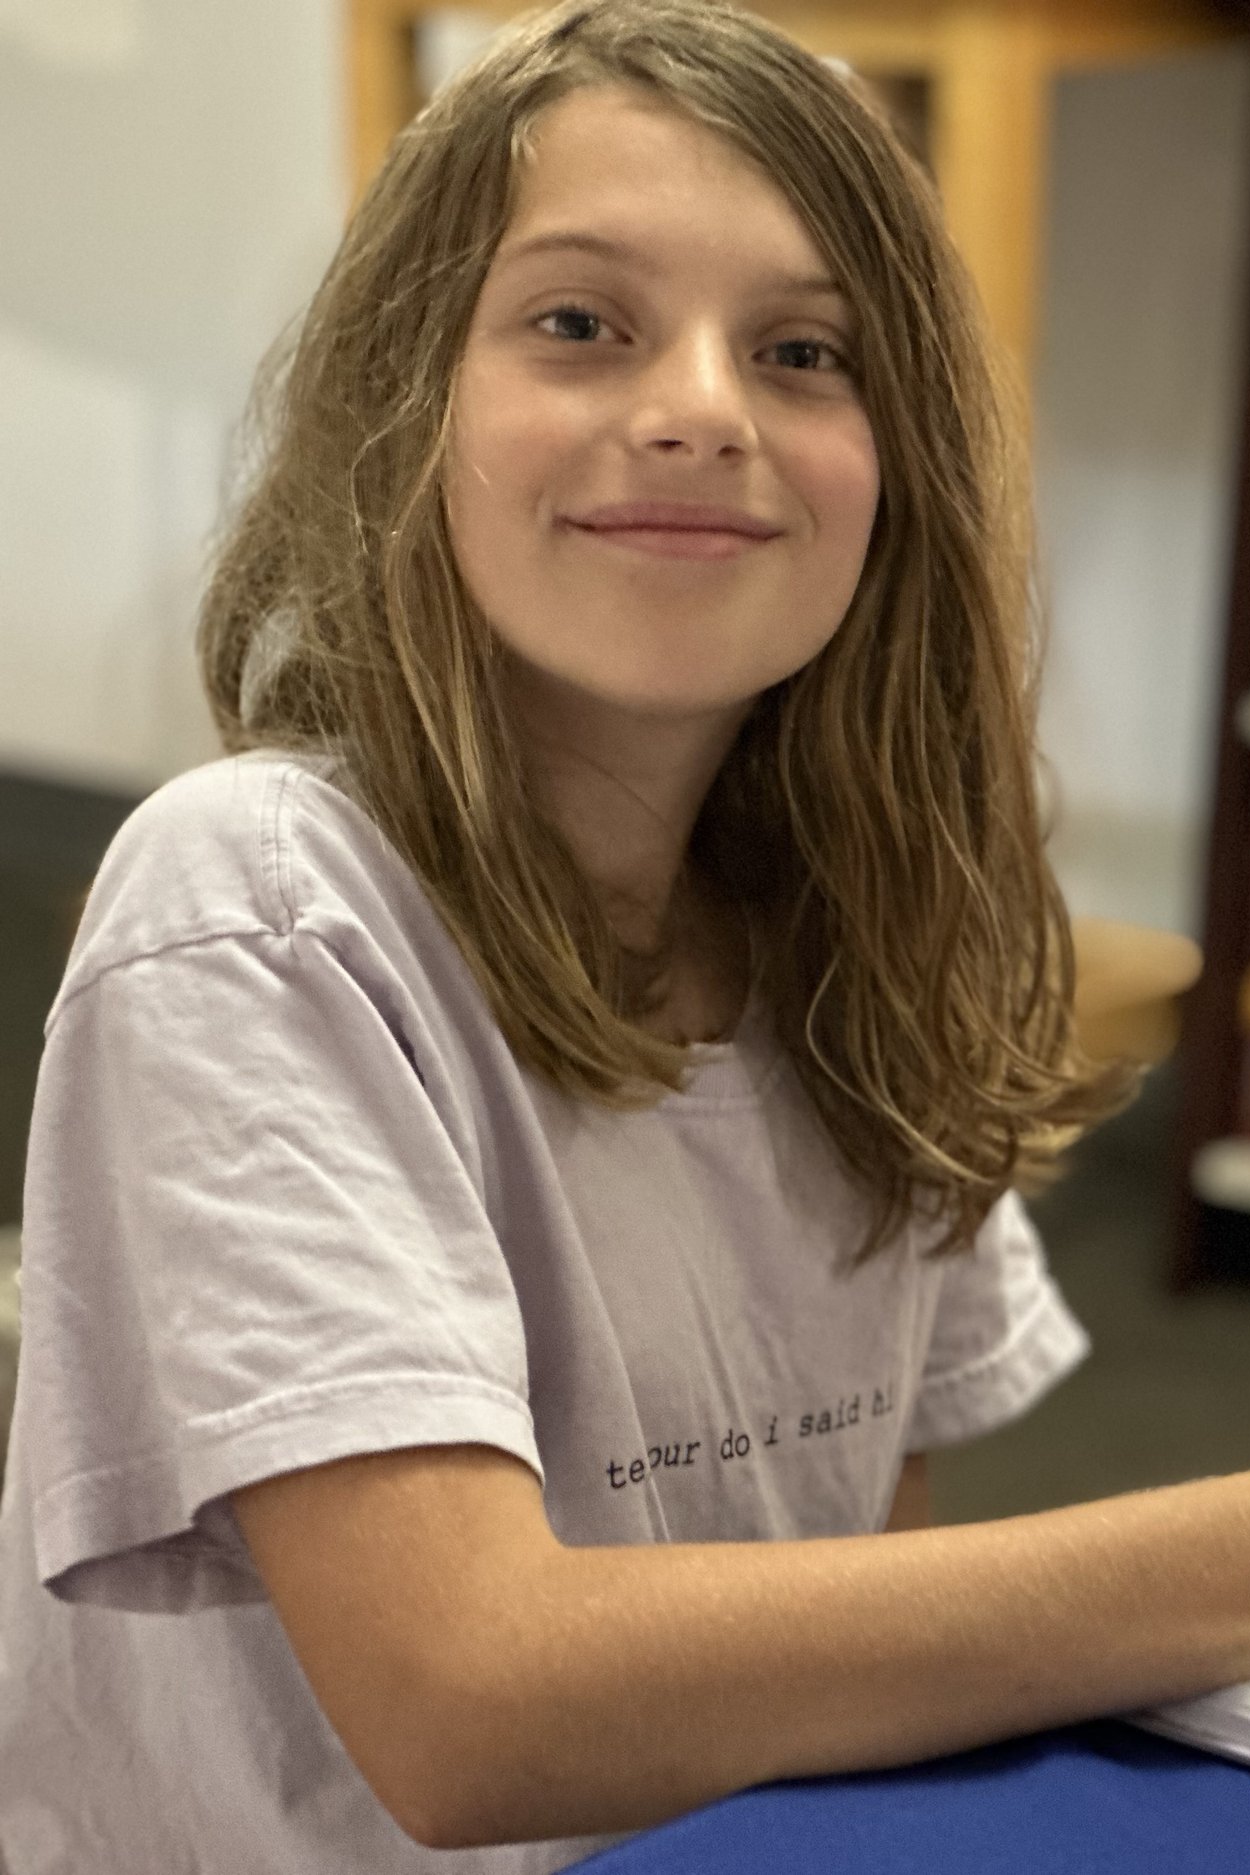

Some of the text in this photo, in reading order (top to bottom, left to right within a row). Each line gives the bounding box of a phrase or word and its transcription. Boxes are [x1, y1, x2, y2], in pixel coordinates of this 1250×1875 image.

[721, 1428, 750, 1460] do
[764, 1415, 779, 1446] i
[798, 1393, 860, 1436] said
